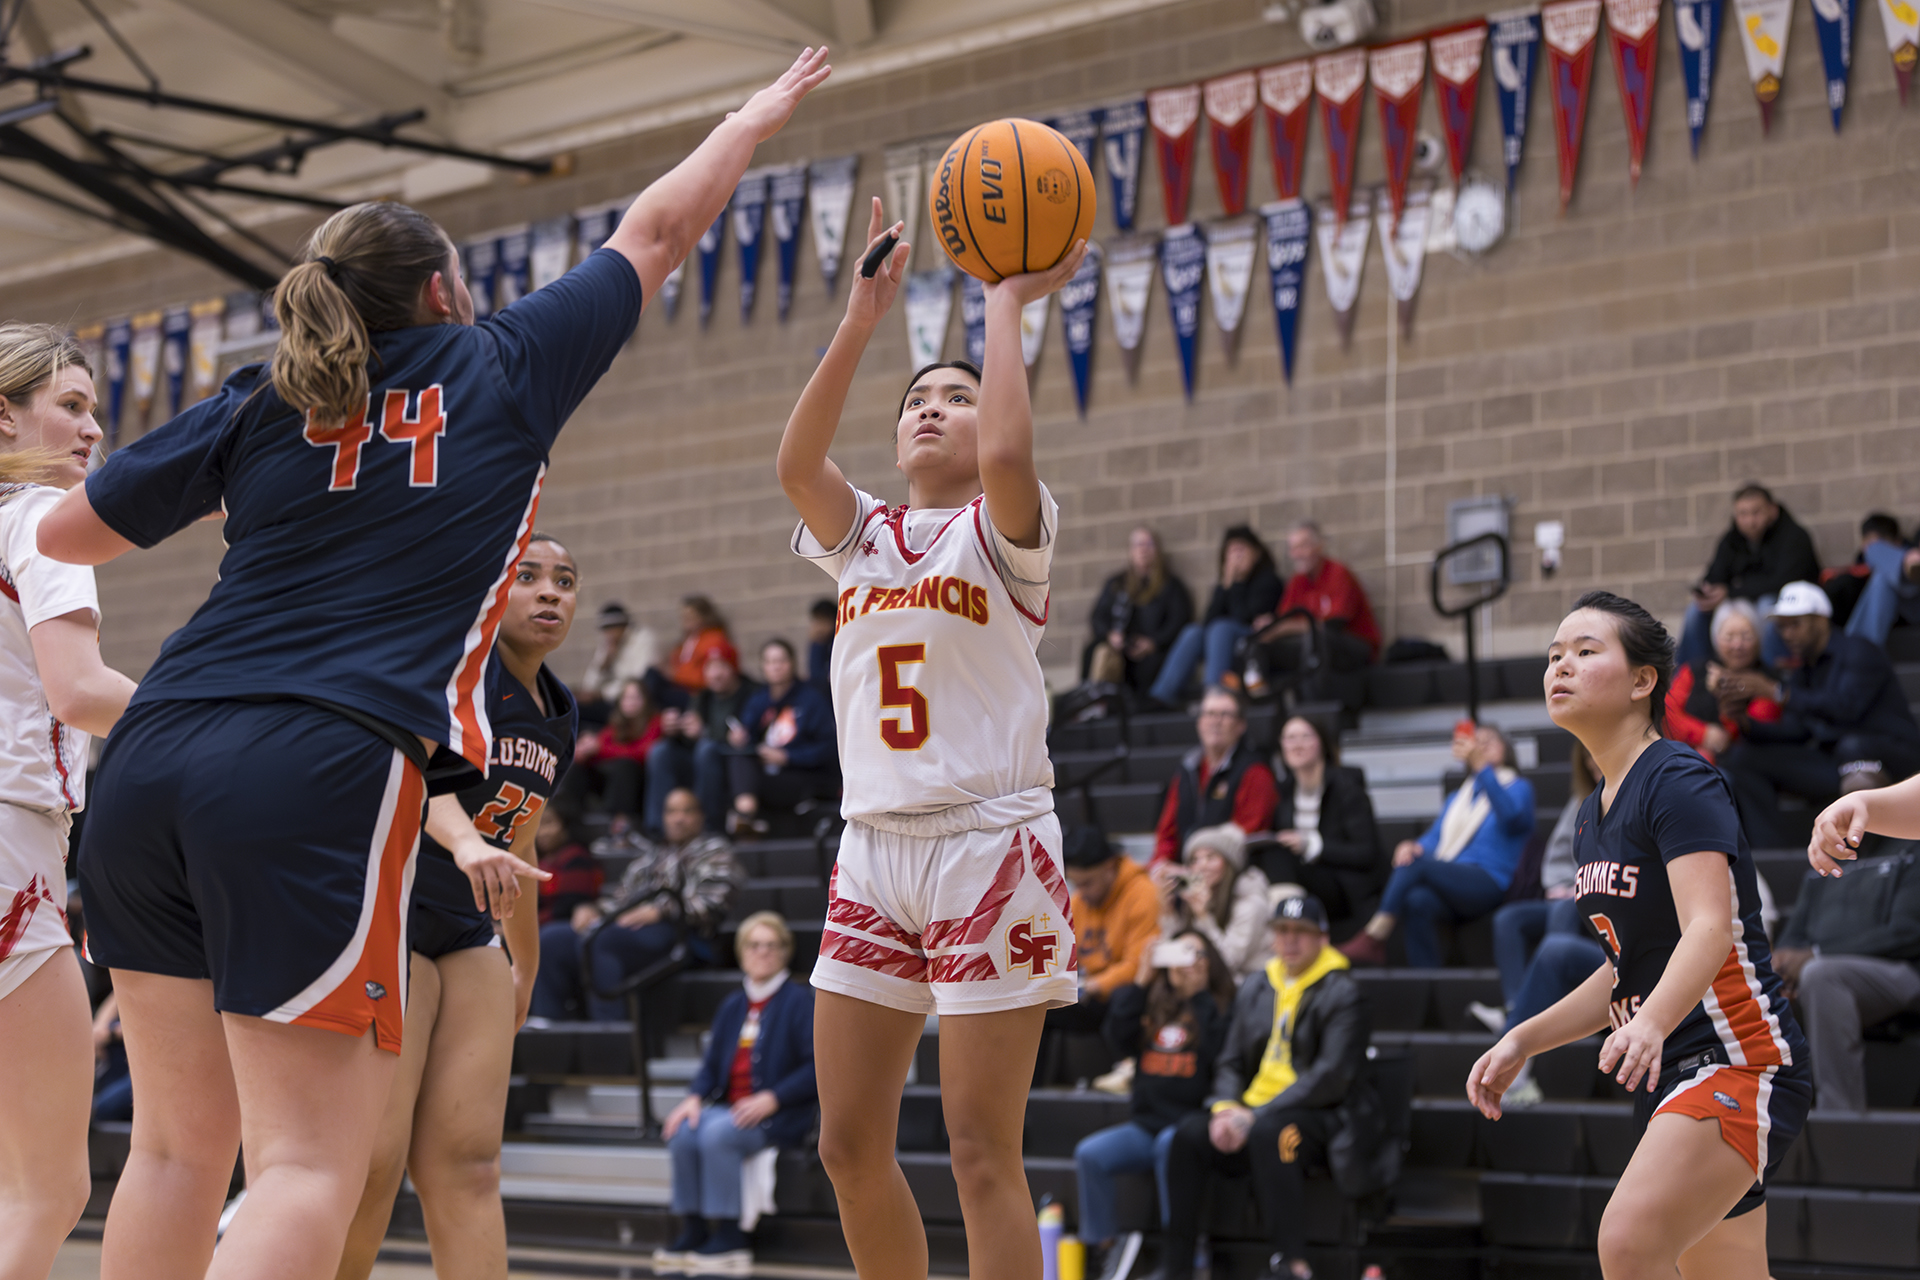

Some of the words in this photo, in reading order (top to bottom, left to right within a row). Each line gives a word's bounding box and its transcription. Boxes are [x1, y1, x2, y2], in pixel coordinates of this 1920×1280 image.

[935, 145, 967, 259] Wilson
[981, 158, 1007, 225] EVO
[302, 383, 448, 492] 44
[860, 575, 990, 627] FRANCIS
[876, 642, 931, 752] 5
[1574, 860, 1641, 902] SUMNES
[1005, 915, 1060, 980] SF
